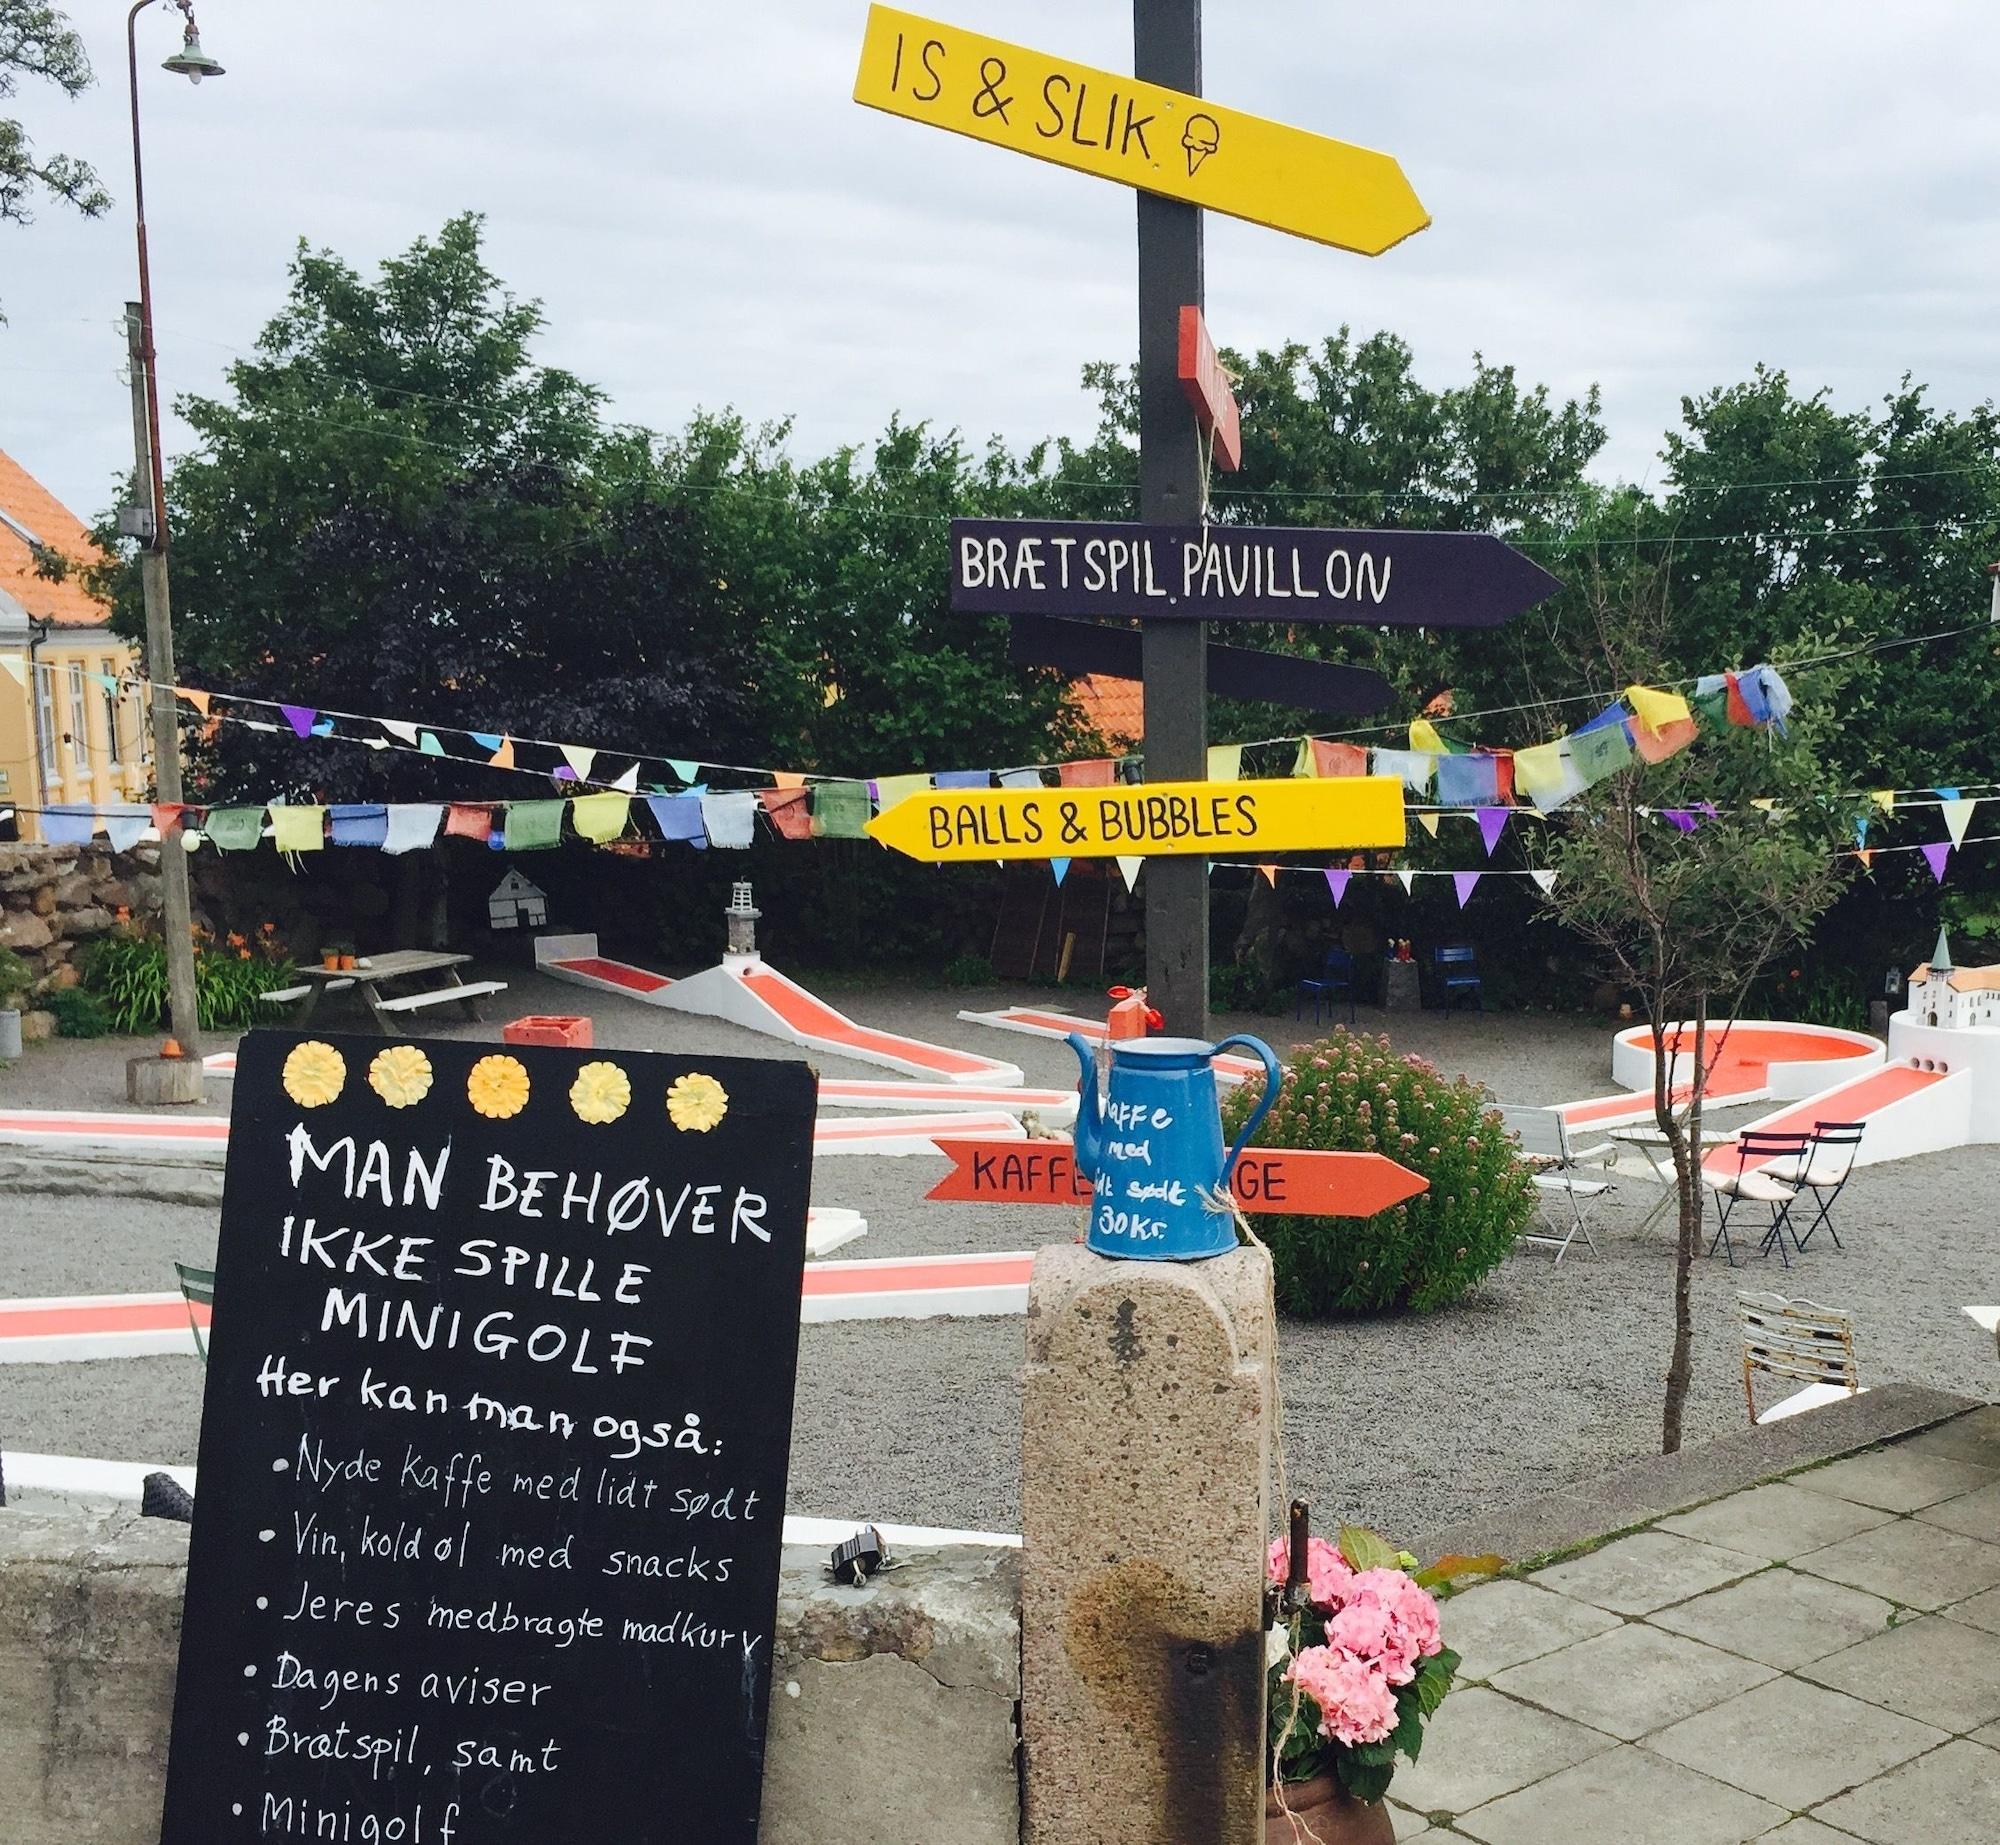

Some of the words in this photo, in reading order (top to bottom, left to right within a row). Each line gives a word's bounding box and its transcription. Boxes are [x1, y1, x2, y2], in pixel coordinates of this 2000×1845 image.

[891, 33, 946, 101] IS
[972, 57, 1014, 126] &
[1035, 74, 1155, 160] SLIK
[961, 537, 1167, 596] BRÆTSPIL
[1183, 537, 1391, 604] PAVILLON
[929, 802, 1043, 849] BALLS
[1059, 801, 1088, 844] &
[1099, 794, 1258, 842] BUBBLES
[284, 1121, 451, 1211] MAN
[478, 1154, 772, 1243] BEHØVER
[973, 1150, 1094, 1196] KAFFE
[281, 1215, 435, 1281] IKKE
[453, 1239, 652, 1305] SPILLE
[321, 1286, 654, 1375] MINIGOLF
[256, 1354, 340, 1398] Her
[360, 1367, 448, 1415] kan
[461, 1391, 575, 1440] man
[592, 1412, 723, 1459] også:
[295, 1432, 382, 1493] Nyde
[512, 1466, 581, 1501] med
[597, 1468, 658, 1509] lidt
[669, 1487, 760, 1521] sødt
[294, 1510, 346, 1564] Vin,
[360, 1515, 422, 1562] kold
[434, 1520, 471, 1568] øl
[501, 1534, 575, 1570] med
[601, 1545, 733, 1582] snacks
[282, 1580, 401, 1629] Jeres
[427, 1600, 604, 1648] medbragte
[622, 1610, 762, 1661] madkurv
[271, 1650, 401, 1711] Dagens
[420, 1666, 552, 1706] aviser
[451, 1738, 562, 1775] samt
[262, 1792, 460, 1845] Minigolf
